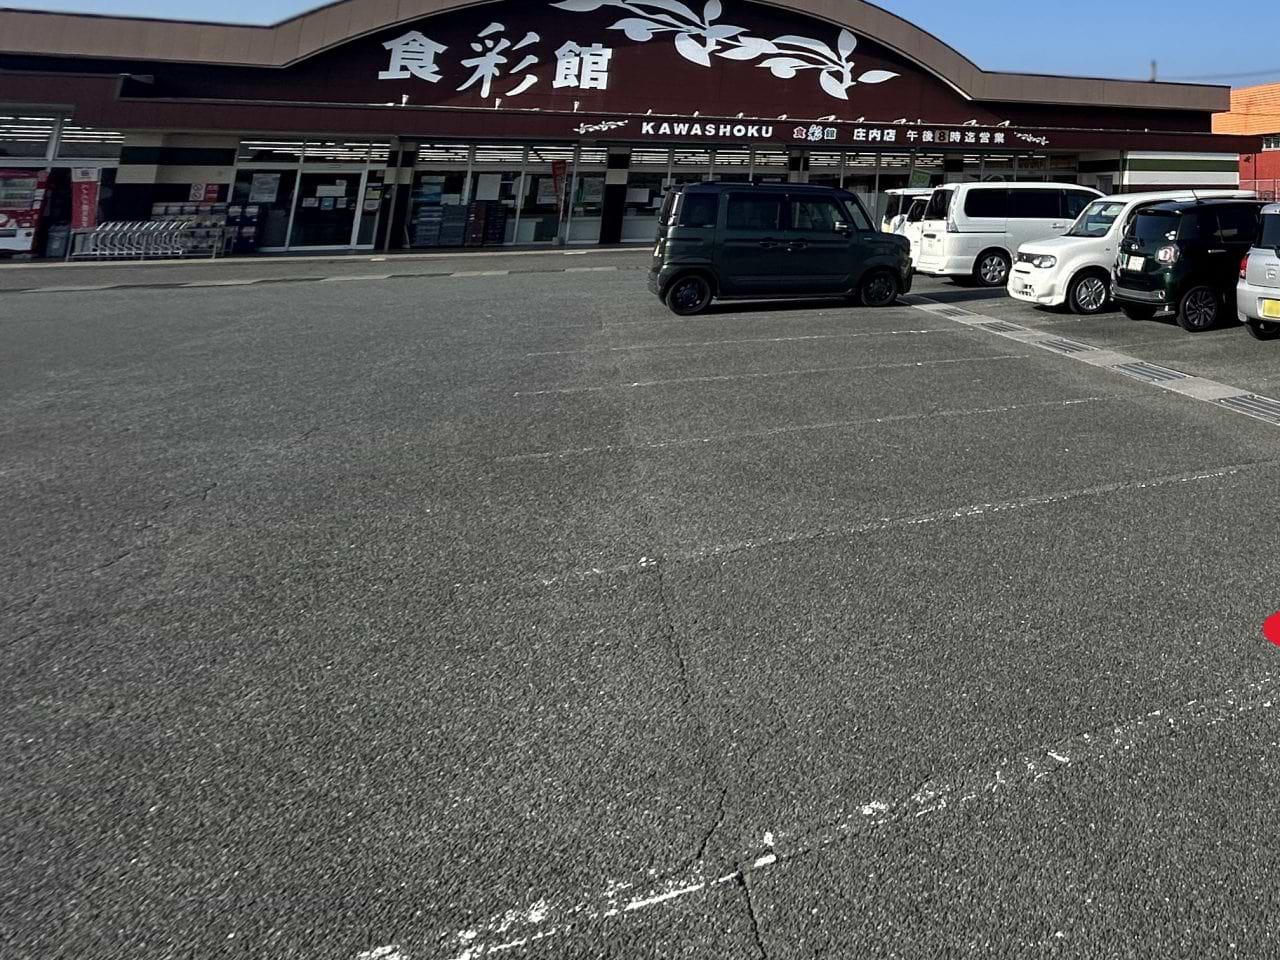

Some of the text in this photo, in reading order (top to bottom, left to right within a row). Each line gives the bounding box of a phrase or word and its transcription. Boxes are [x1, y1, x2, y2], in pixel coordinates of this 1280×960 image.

[378, 22, 613, 99] 食彩館
[641, 122, 773, 138] KAWASHOKU
[853, 128, 897, 142] 庄内店
